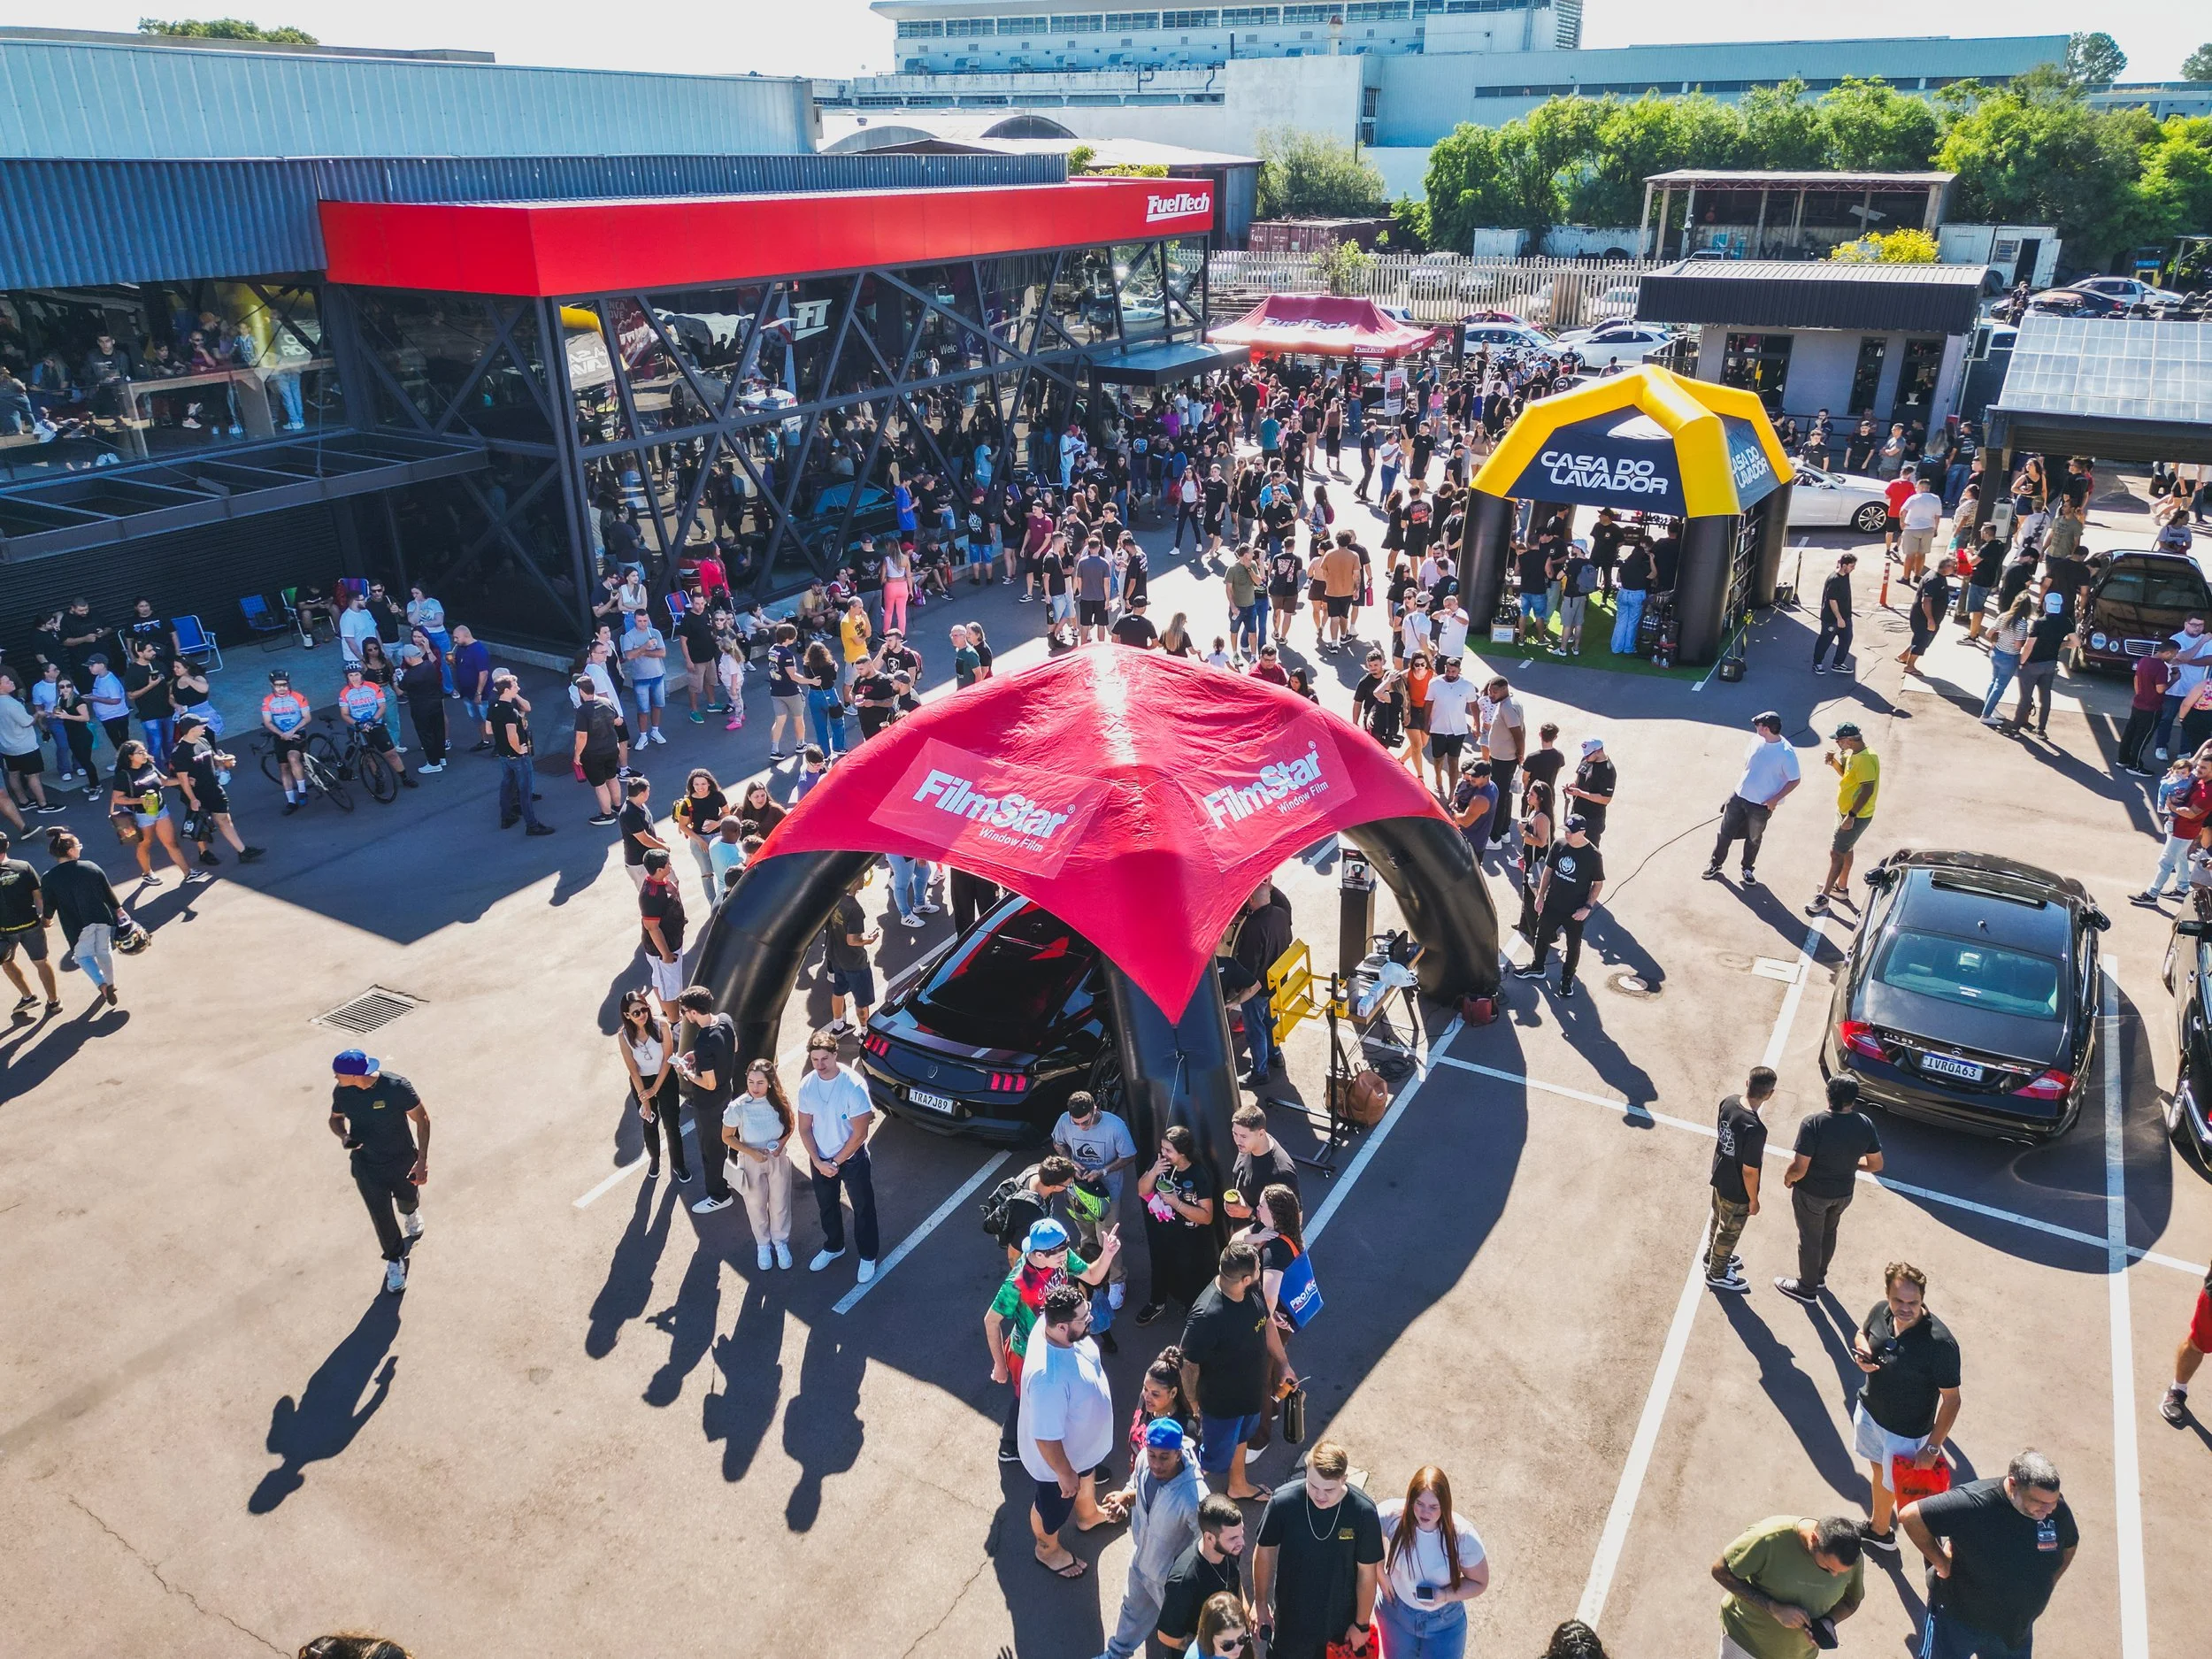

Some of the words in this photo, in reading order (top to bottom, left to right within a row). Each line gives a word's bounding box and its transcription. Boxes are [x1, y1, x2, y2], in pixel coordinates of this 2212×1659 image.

[1147, 192, 1210, 216] FuelTech
[1263, 316, 1351, 331] FuelTech
[1540, 450, 1609, 474] CASA
[1616, 458, 1655, 478] DO
[1745, 445, 1760, 465] DO
[1549, 467, 1668, 495] LAVADOR
[1736, 457, 1770, 488] LAVADOR
[1277, 789, 1308, 814] Window
[1307, 780, 1330, 802] Film
[979, 826, 1020, 848] Window
[1018, 837, 1044, 853] Film
[913, 1091, 949, 1110] TRA7J89
